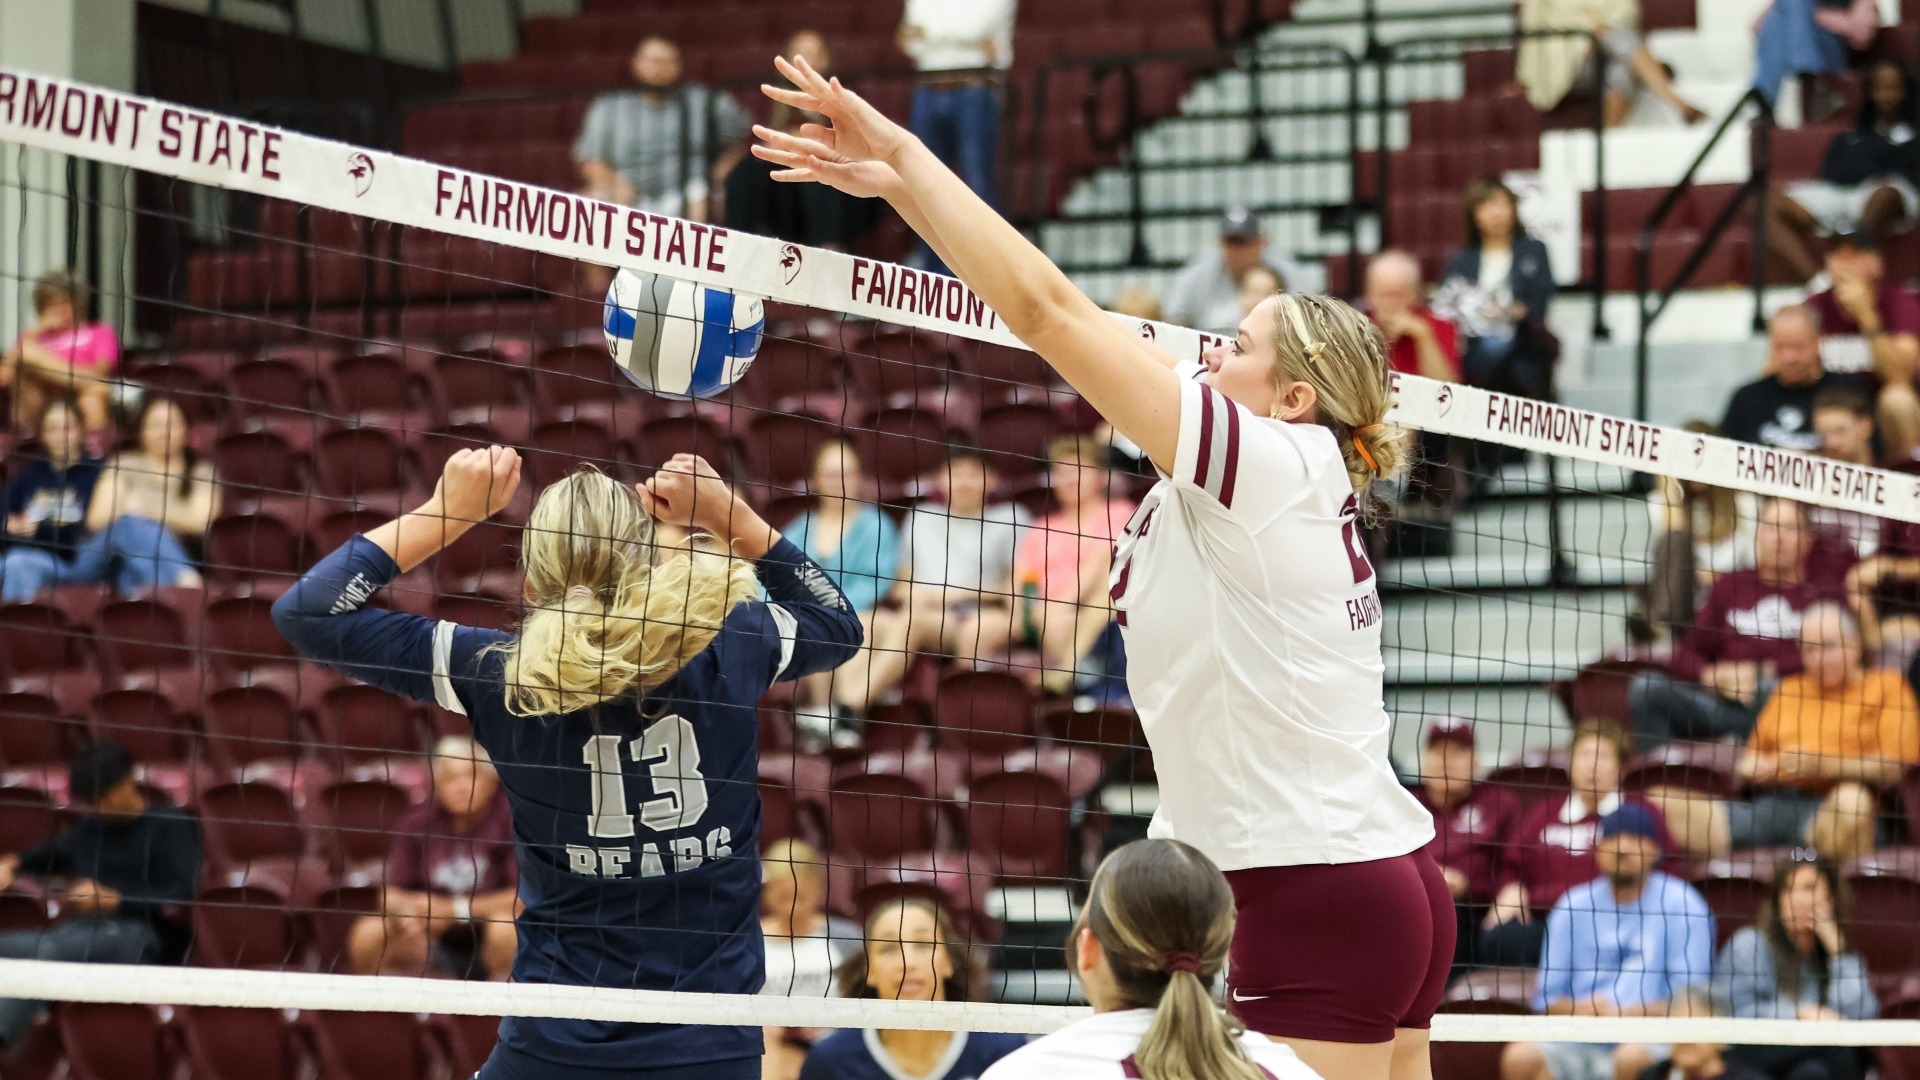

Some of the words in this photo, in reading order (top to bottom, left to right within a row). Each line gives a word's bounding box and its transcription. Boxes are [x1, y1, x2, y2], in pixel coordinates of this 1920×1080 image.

[159, 109, 282, 181] STATE
[435, 169, 618, 250] FAIRMONT
[625, 213, 728, 273] STATE
[1486, 394, 1594, 448] FAIRMONT
[1600, 418, 1661, 462] STATE
[1736, 445, 1828, 491] FAIRMONT
[1831, 465, 1885, 505] STATE
[583, 714, 708, 838] 13
